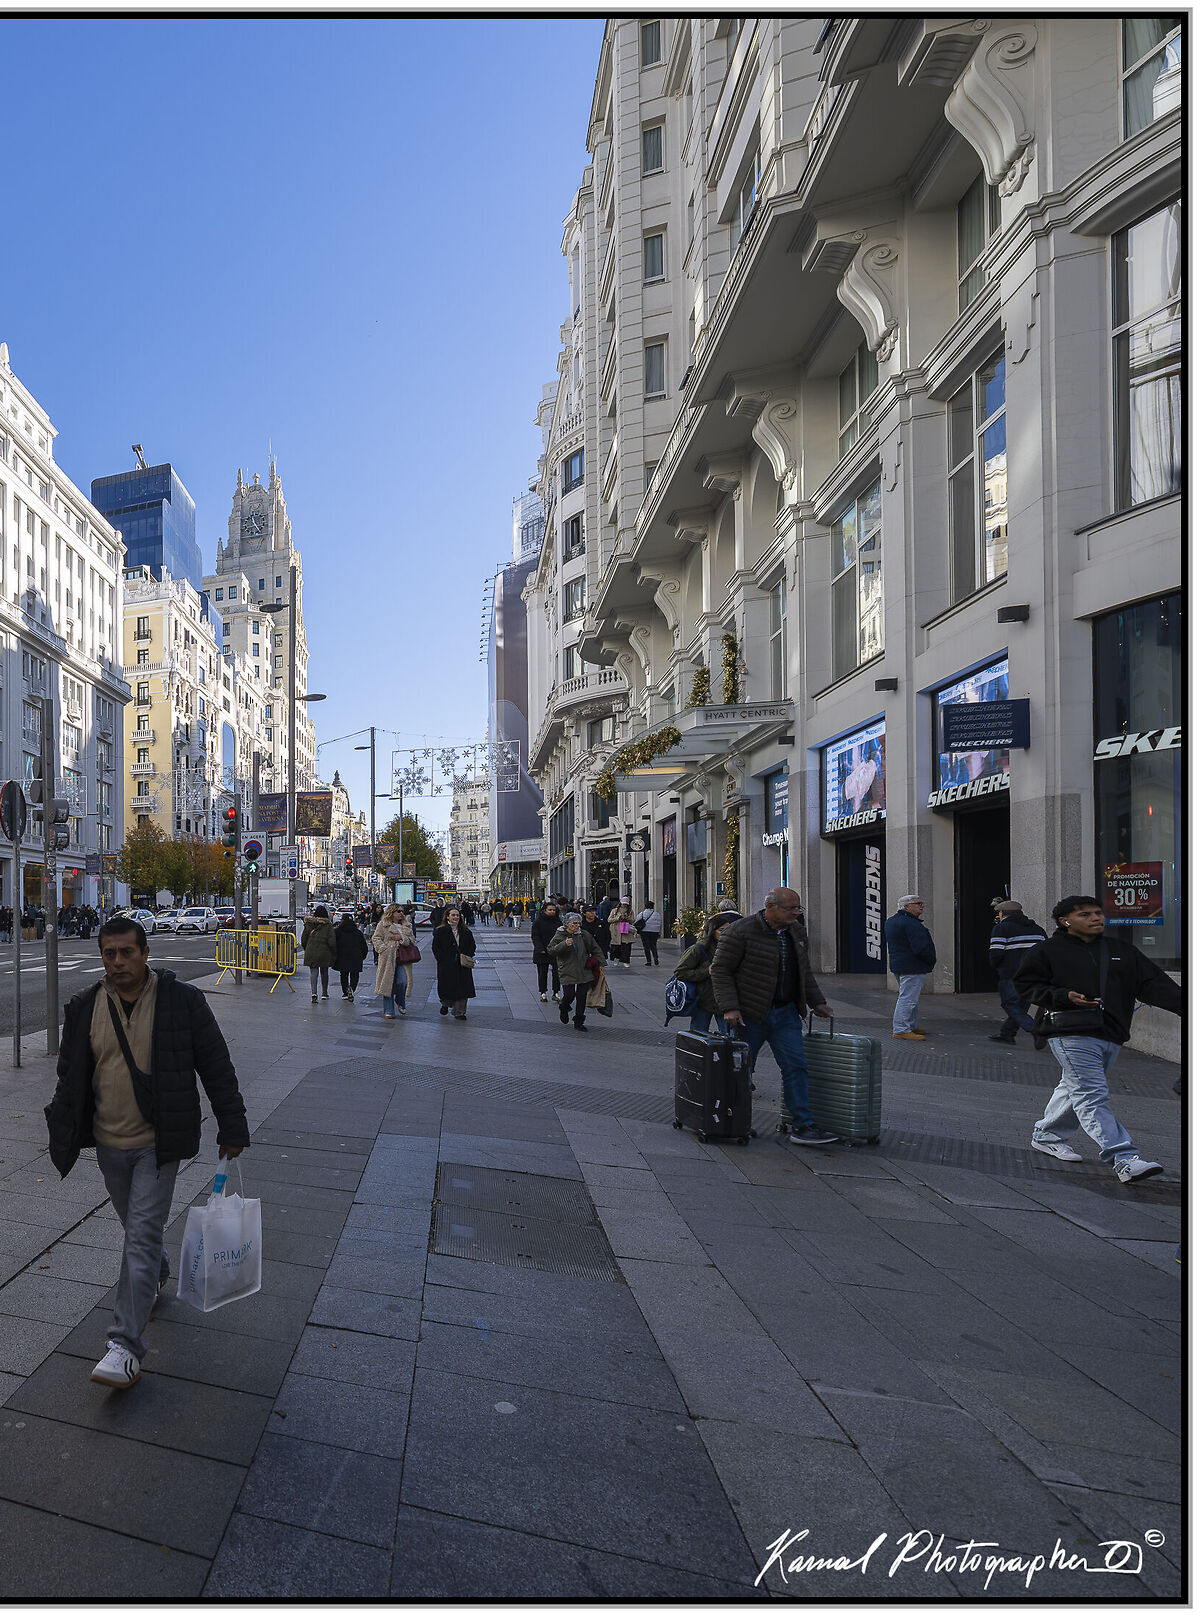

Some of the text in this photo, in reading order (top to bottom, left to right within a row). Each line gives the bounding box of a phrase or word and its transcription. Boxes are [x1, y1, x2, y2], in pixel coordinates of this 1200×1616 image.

[705, 708, 787, 721] HYATT CENTRIC
[949, 738, 1013, 748] SKECHERS
[927, 772, 1010, 808] SKECHERS
[825, 808, 878, 833] SKECHERS
[762, 832, 784, 846] Change
[1113, 872, 1150, 880] PROMOCIÓN
[1119, 879, 1158, 887] NAVIDAD
[865, 844, 881, 961] SKECHERS
[1114, 887, 1135, 906] 30
